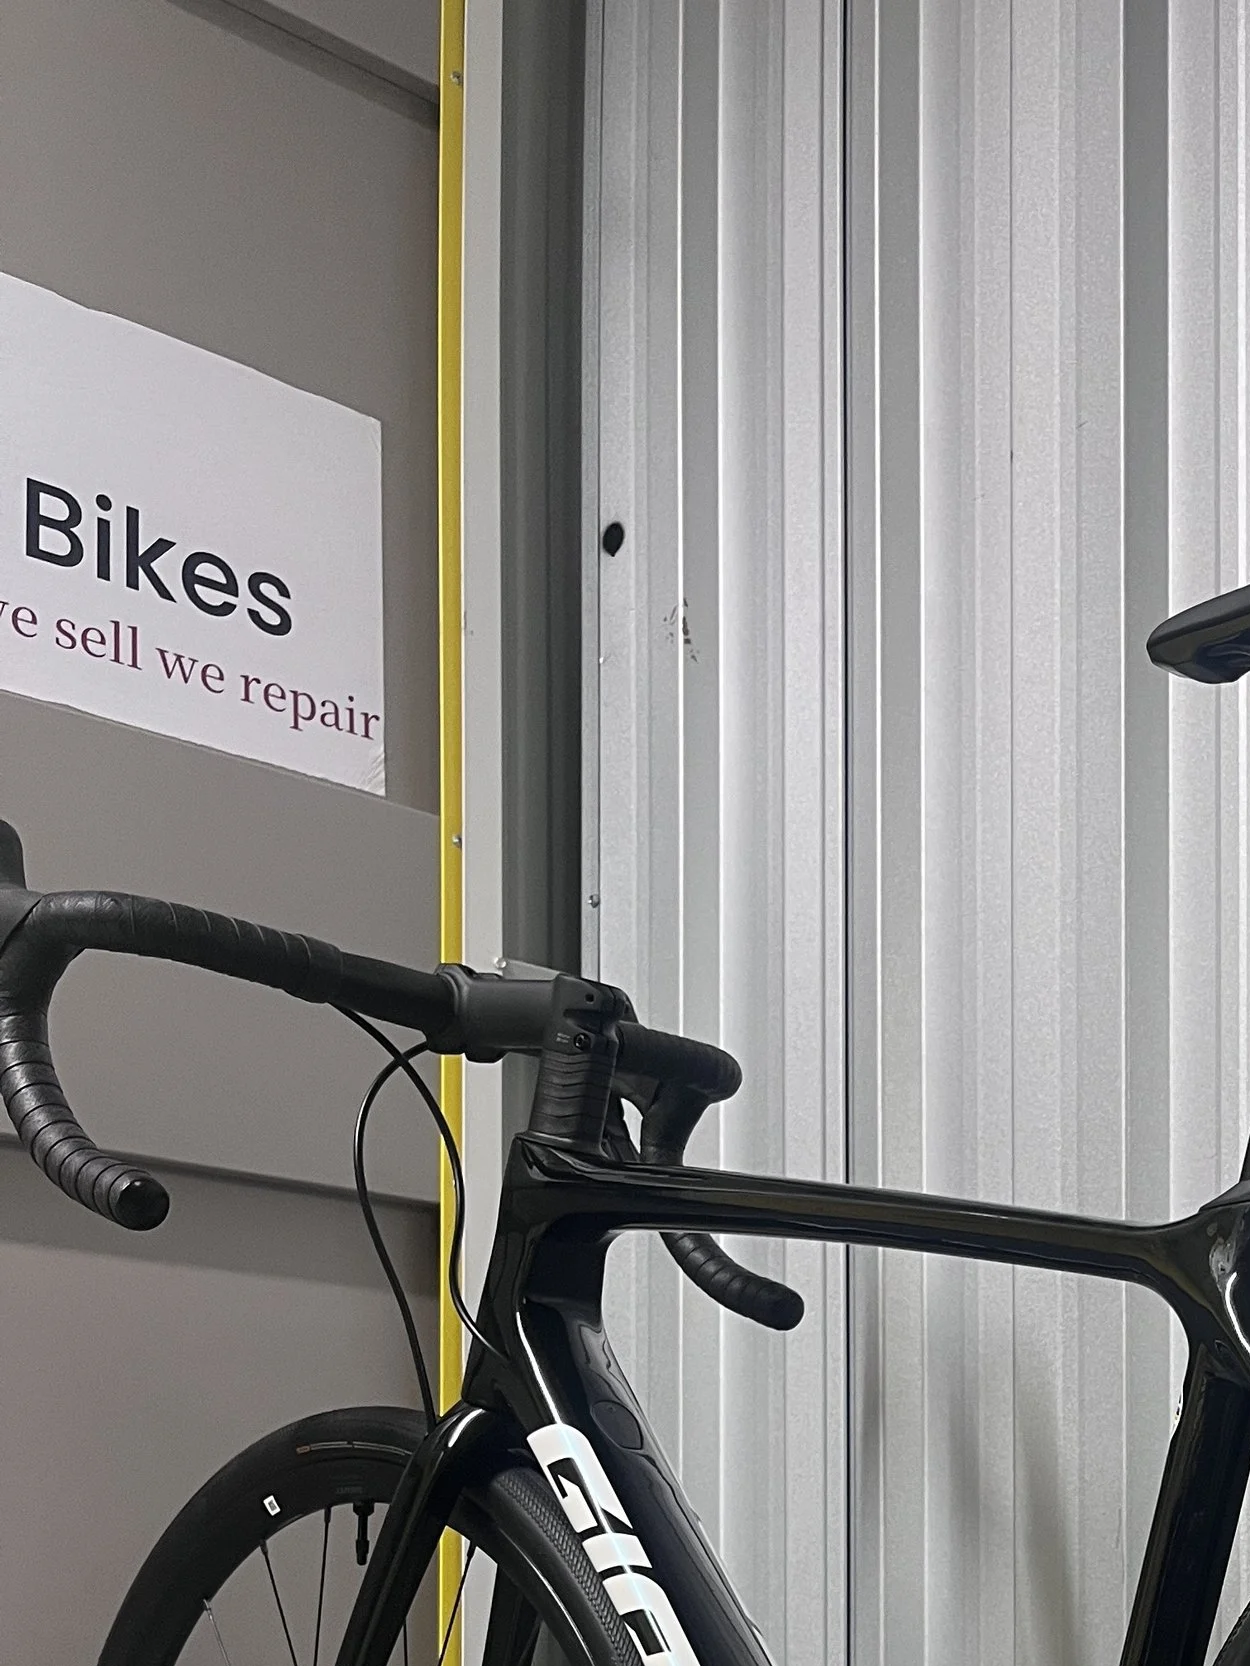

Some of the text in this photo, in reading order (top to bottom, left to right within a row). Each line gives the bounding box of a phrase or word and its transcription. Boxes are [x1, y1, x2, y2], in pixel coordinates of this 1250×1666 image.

[25, 478, 292, 636] Bikes
[0, 601, 380, 740] e sell we repair
